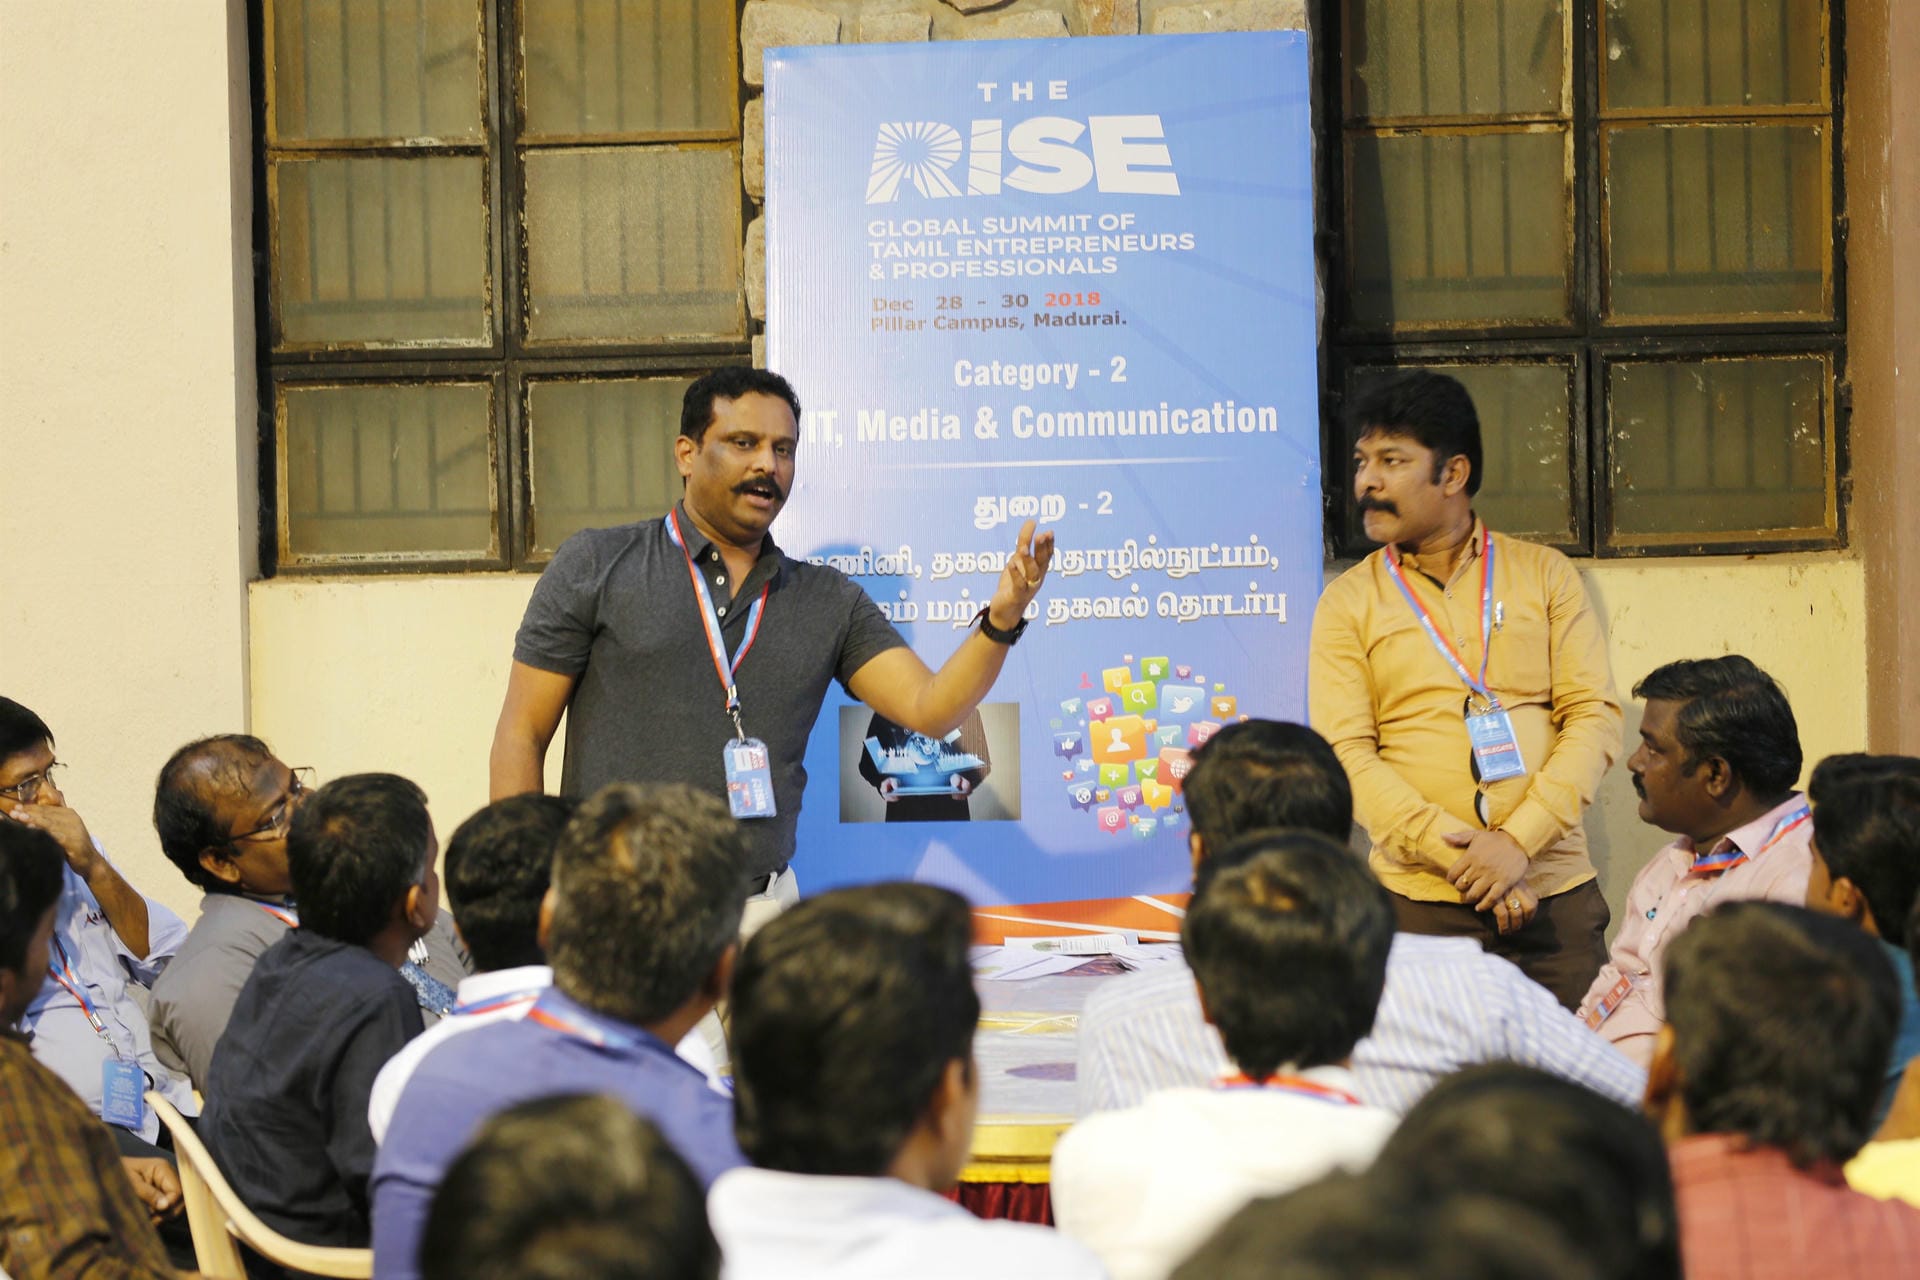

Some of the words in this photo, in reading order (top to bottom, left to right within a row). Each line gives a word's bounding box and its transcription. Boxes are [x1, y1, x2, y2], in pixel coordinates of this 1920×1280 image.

[977, 80, 1069, 102] THE
[865, 114, 1182, 205] RISE
[867, 217, 977, 238] GLOBAL
[982, 213, 1093, 235] SUMMIT
[1098, 212, 1137, 231] OF
[867, 239, 951, 260] TAMIL
[956, 232, 1196, 258] ENTREPRENEURS
[868, 261, 886, 281] &
[892, 256, 1119, 280] PROFESSIONALS
[872, 297, 915, 313] Dec
[935, 295, 964, 310] 28
[1001, 294, 1030, 308] 30
[1044, 291, 1102, 308] 2018
[871, 315, 928, 332] Pillar
[933, 315, 1026, 332] Campus,
[1033, 310, 1128, 328] Madurai.
[954, 359, 1079, 391] Category
[1110, 356, 1128, 384] 2
[805, 410, 844, 448] IT,
[856, 408, 961, 443] Media
[973, 405, 1000, 440] &
[1011, 399, 1278, 440] Communication
[973, 493, 1067, 530] துறை
[1096, 490, 1113, 515] 2
[930, 537, 1017, 581] தகவ
[1046, 582, 1150, 627] தகவல்
[1156, 581, 1288, 624] தொடர்பு
